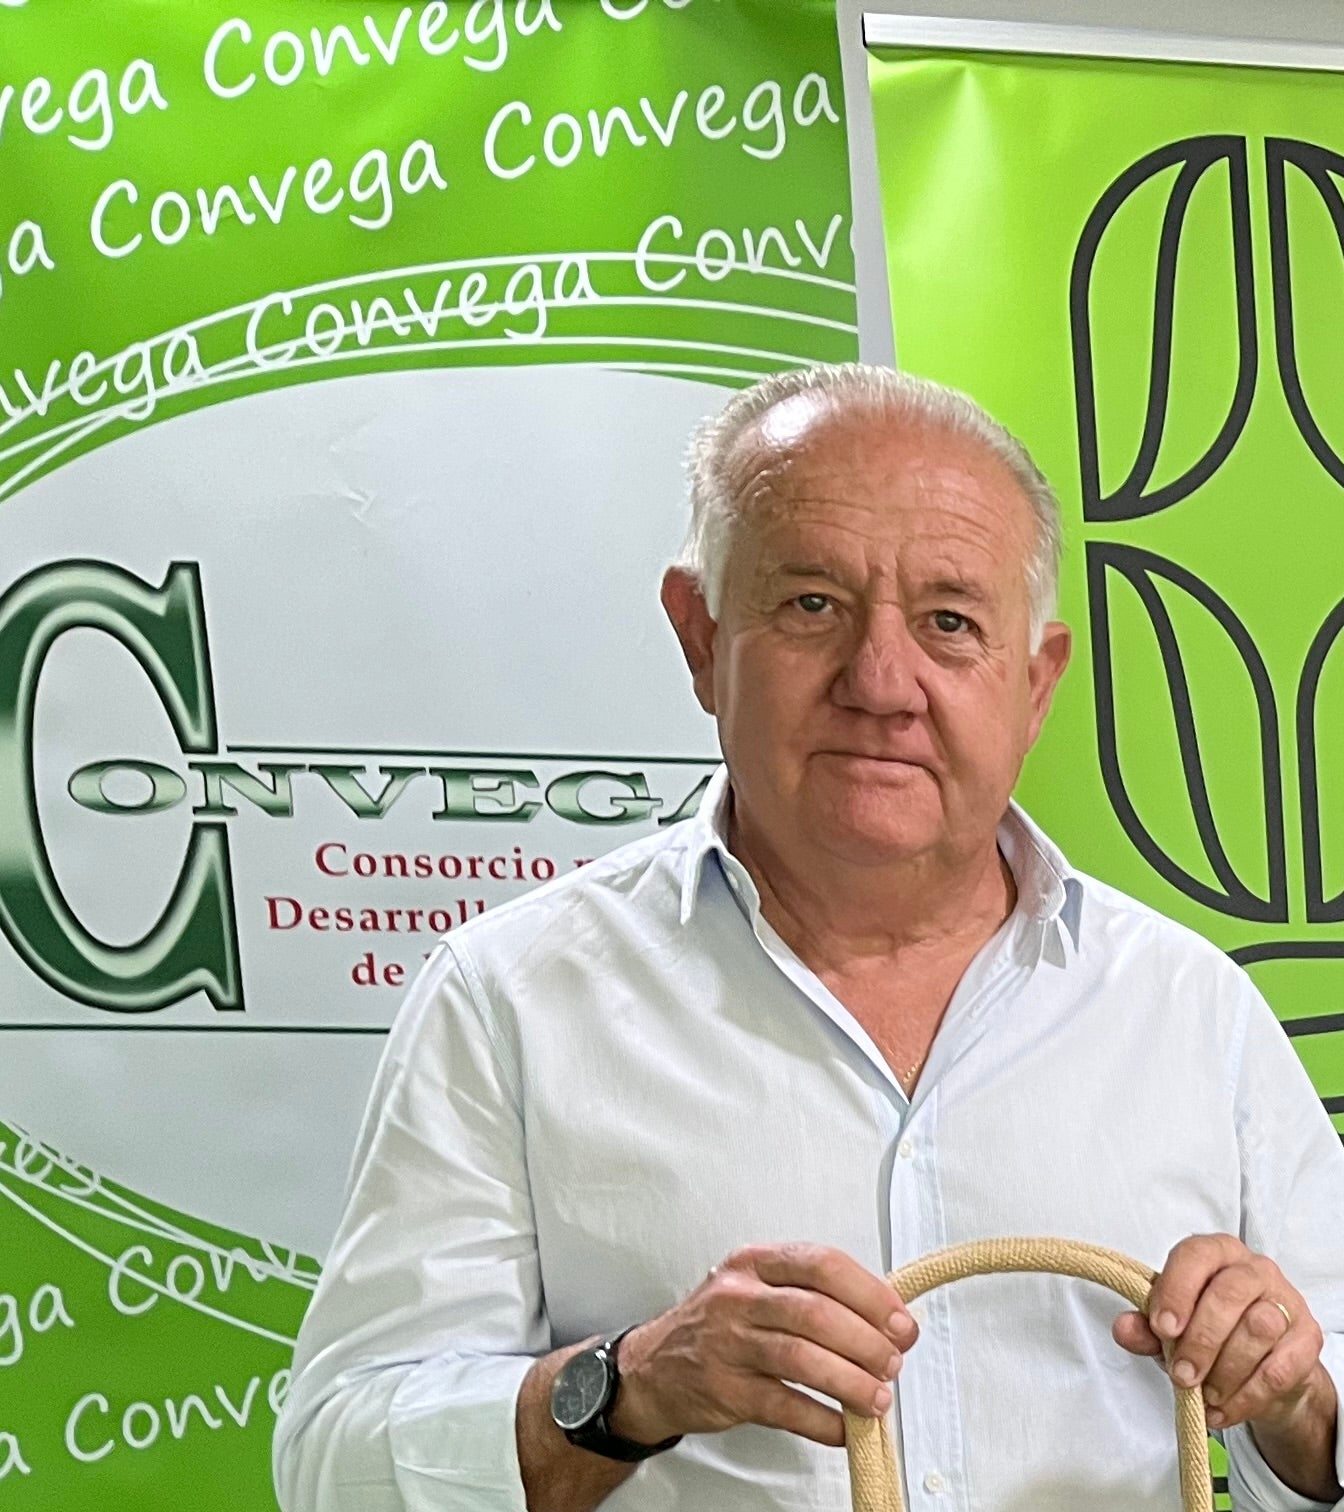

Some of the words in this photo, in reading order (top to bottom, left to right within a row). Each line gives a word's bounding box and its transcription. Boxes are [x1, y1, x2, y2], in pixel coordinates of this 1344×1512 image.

[203, 0, 563, 98] Convega
[90, 138, 448, 259] Convega
[484, 72, 842, 180] Convega
[246, 257, 598, 368] Convega
[635, 213, 845, 292] Conv
[315, 842, 555, 881] Consorcio
[351, 953, 405, 986] de
[64, 1367, 295, 1463] Conve
